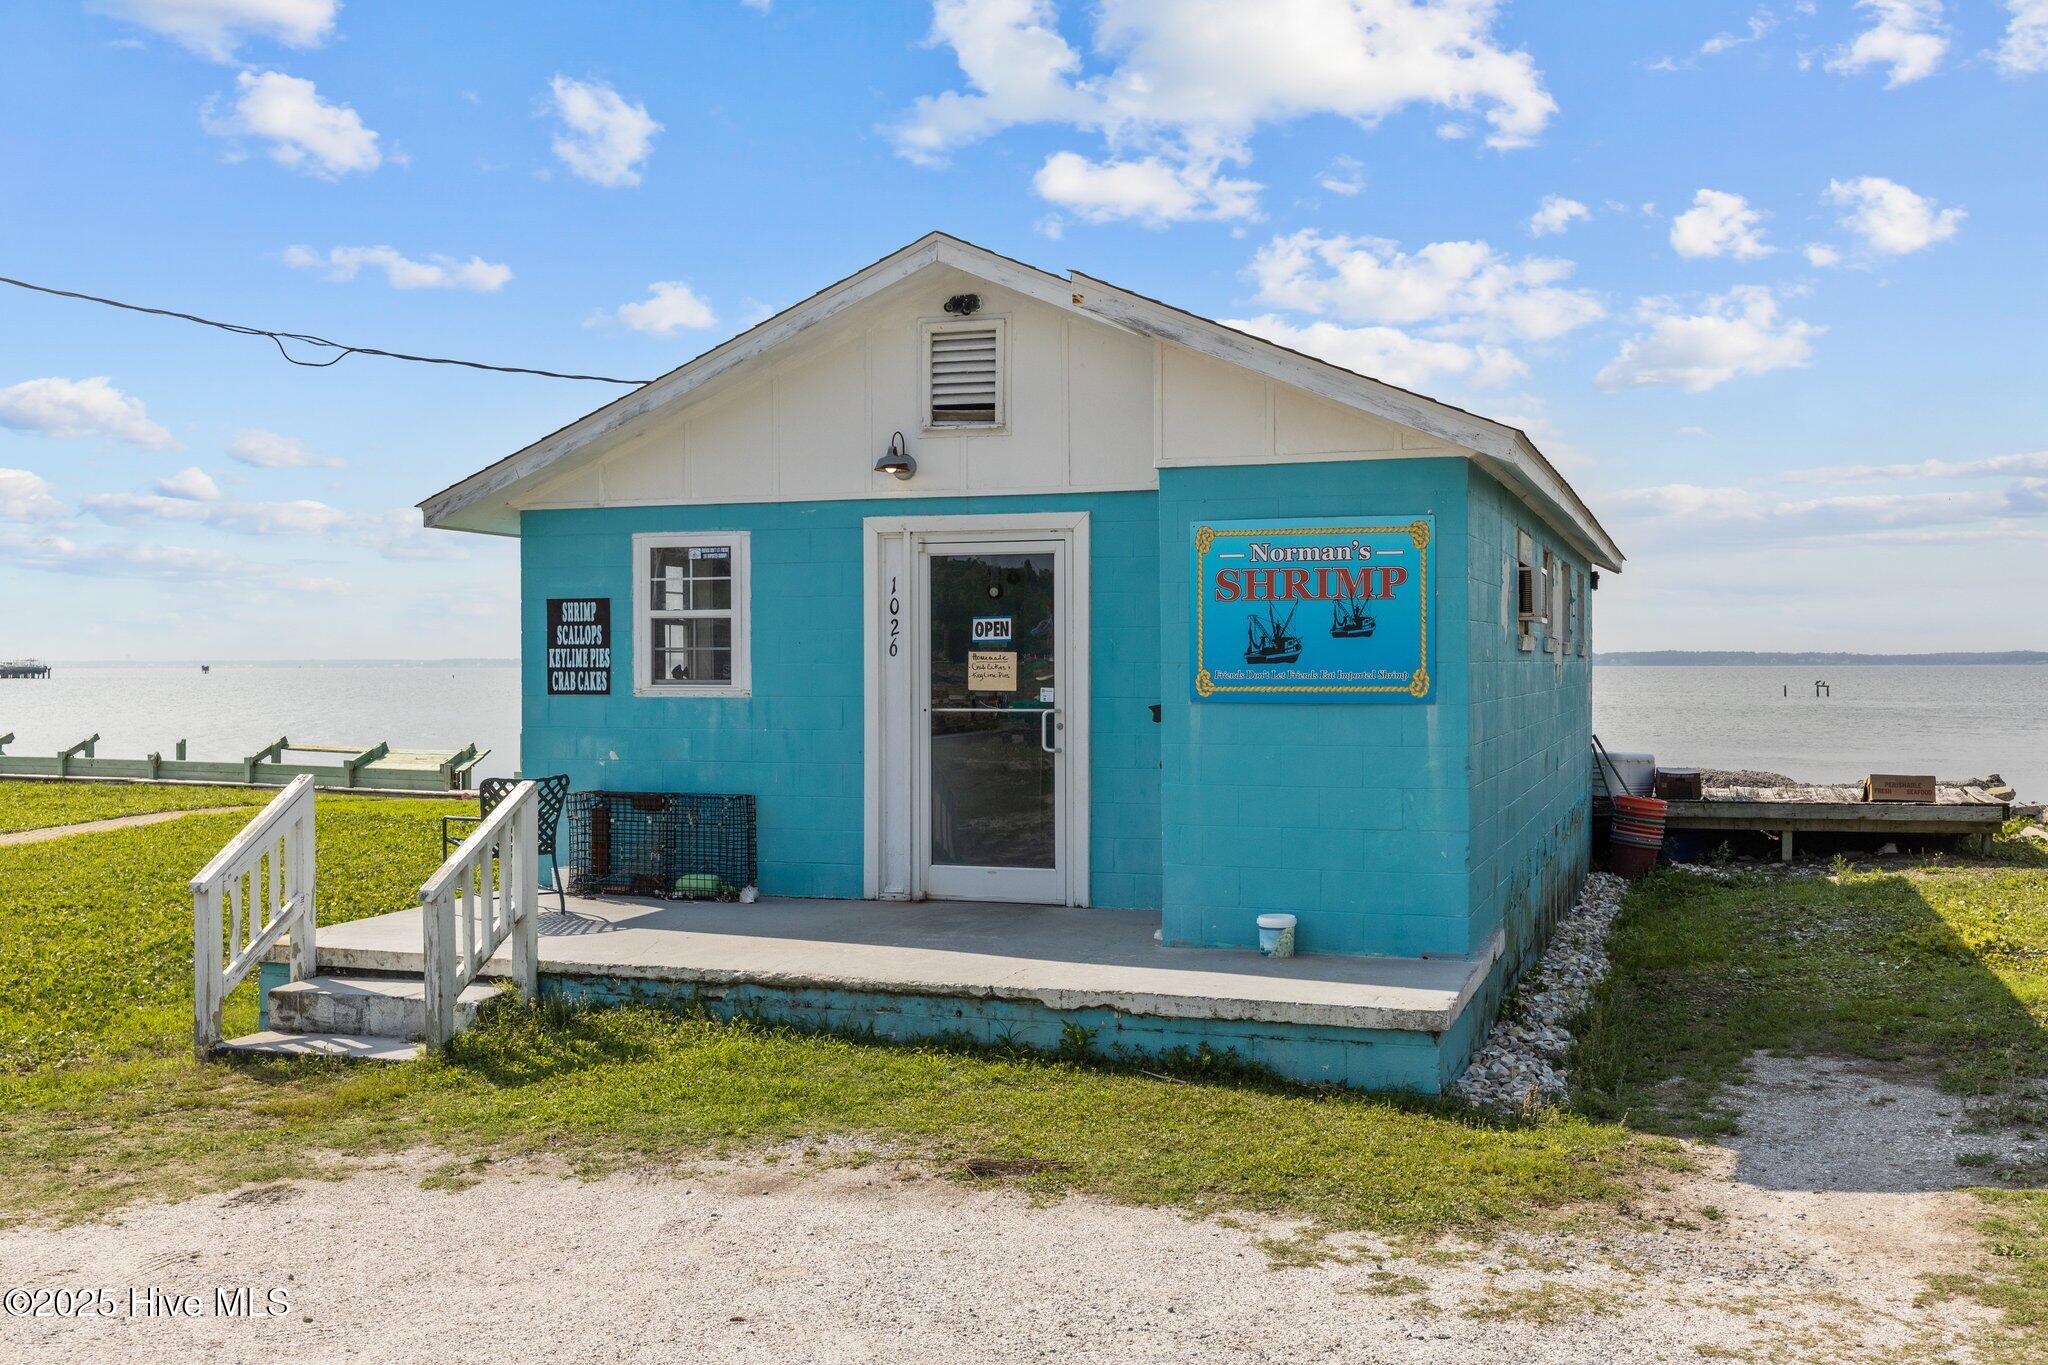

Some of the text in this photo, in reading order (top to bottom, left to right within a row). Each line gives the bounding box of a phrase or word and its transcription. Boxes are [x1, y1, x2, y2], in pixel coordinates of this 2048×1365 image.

[1249, 540, 1372, 563] Norman's
[1214, 565, 1409, 602] SHRIMP
[562, 601, 597, 622] SHRIMP
[889, 576, 900, 657] 1026
[556, 625, 602, 645] SCALLOPS
[975, 621, 1009, 637] OPEN
[549, 648, 610, 668] KEYLIME PIES
[972, 652, 1008, 661] Homemade
[552, 671, 607, 691] CRAB CAKES
[1214, 669, 1409, 682] Friends Don't Let Friends Eat Imported Shrimp
[1906, 788, 1933, 796] SEAFOOD
